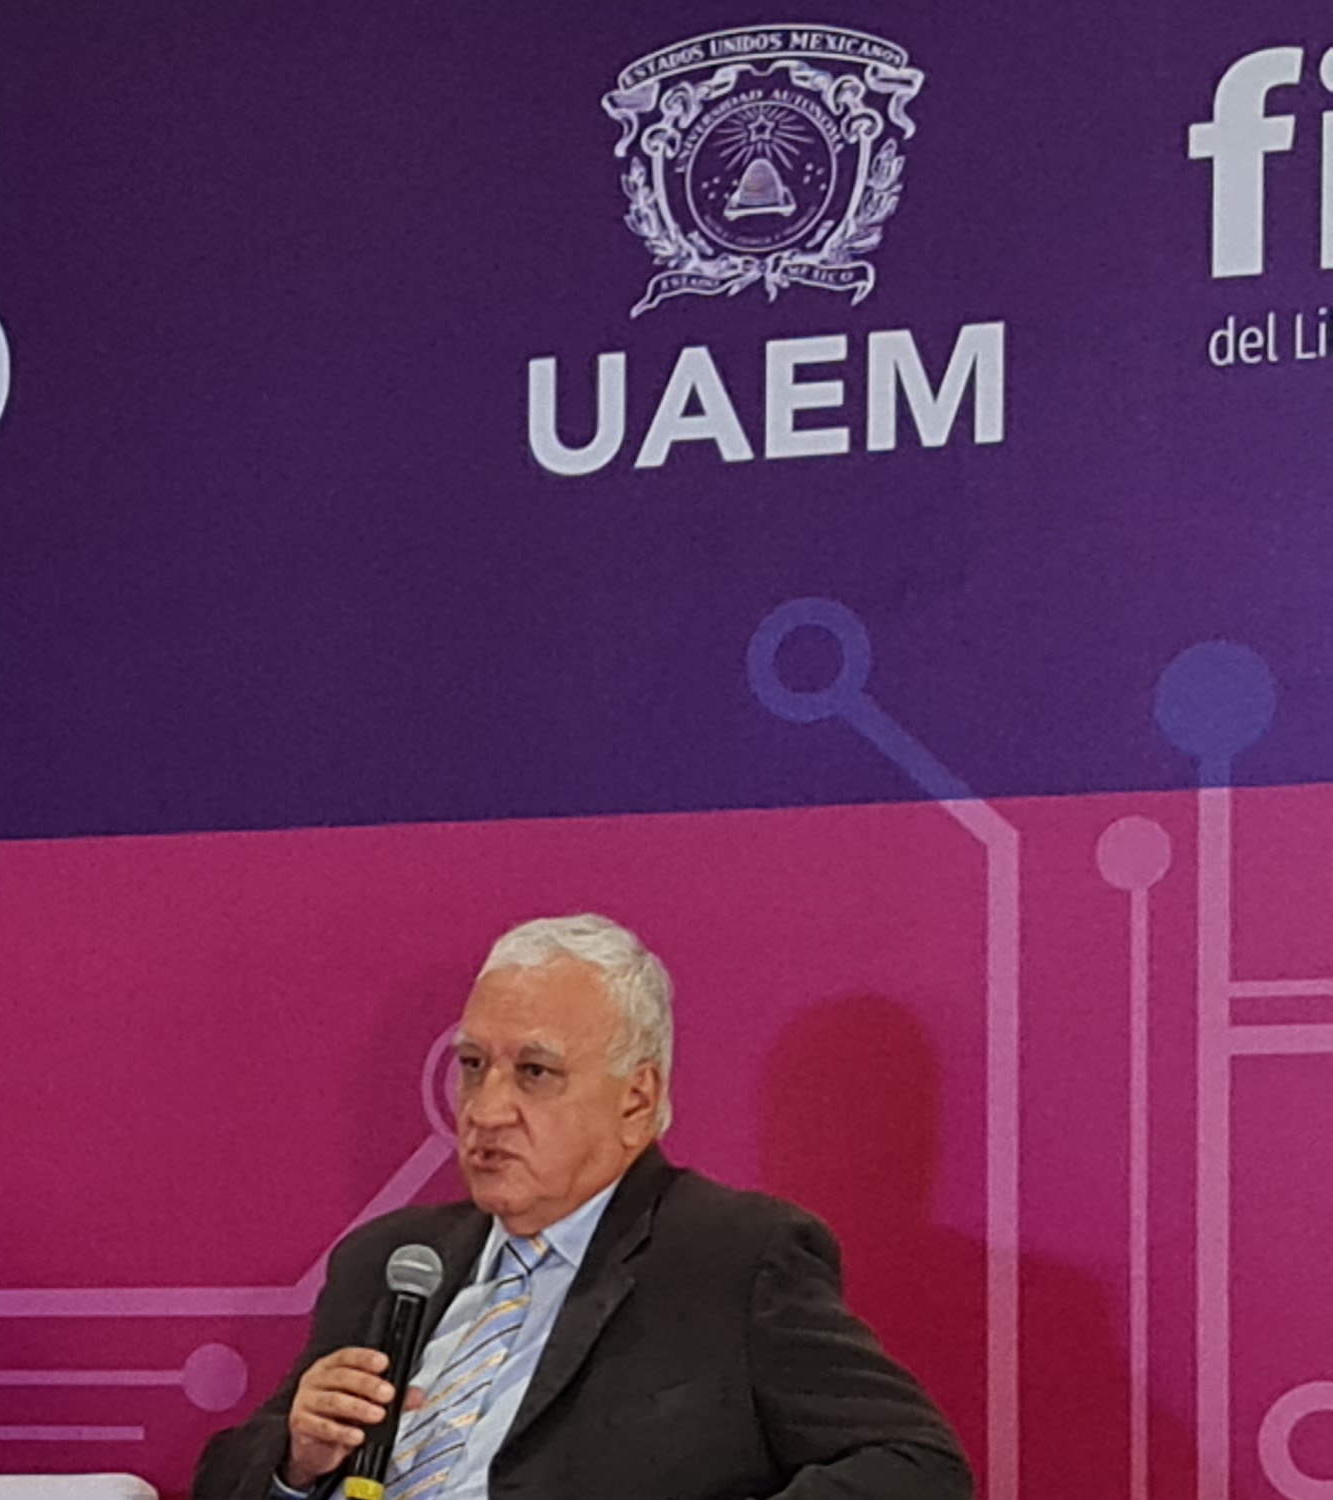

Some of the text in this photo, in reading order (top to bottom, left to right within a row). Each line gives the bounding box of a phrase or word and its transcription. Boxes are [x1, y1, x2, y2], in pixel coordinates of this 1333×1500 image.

[621, 30, 902, 87] ESTADOS UNIDOS MEXICANOS
[1208, 311, 1278, 366] del
[528, 321, 1005, 476] UAEM
